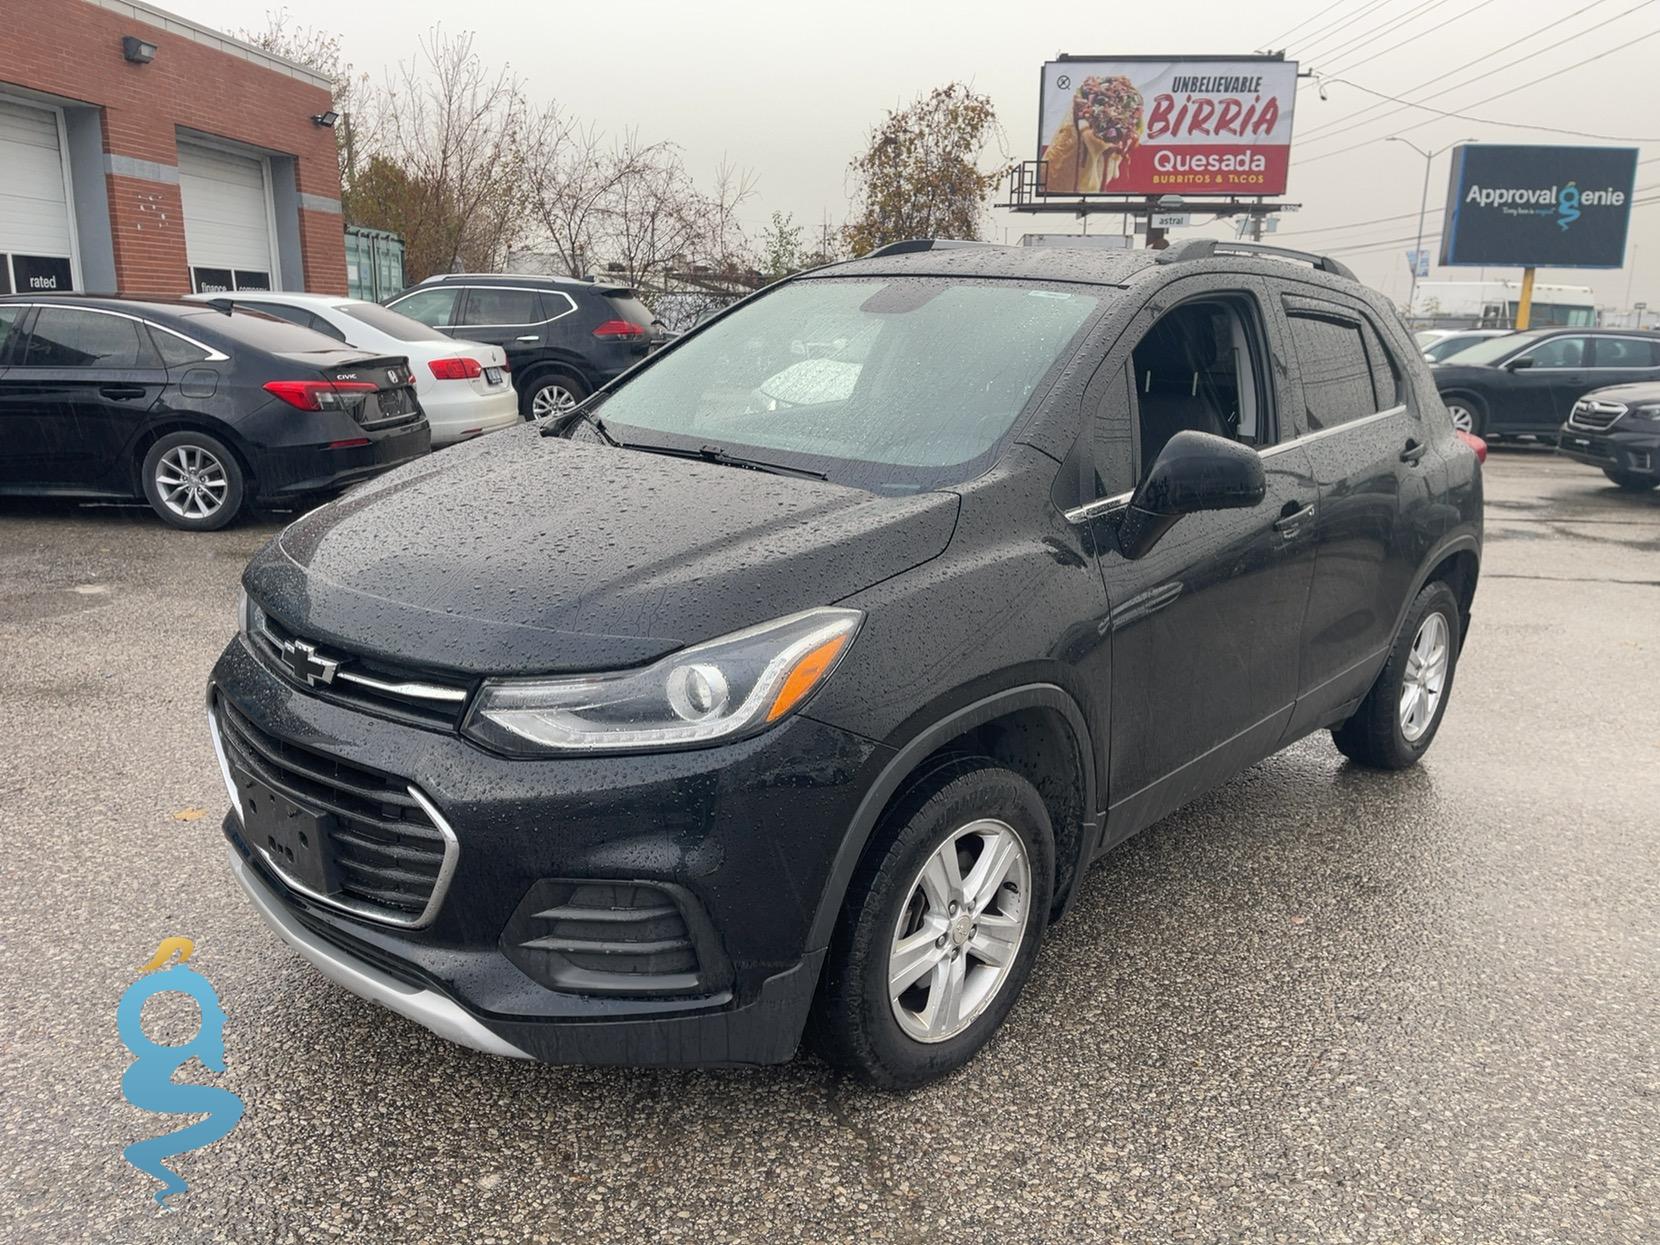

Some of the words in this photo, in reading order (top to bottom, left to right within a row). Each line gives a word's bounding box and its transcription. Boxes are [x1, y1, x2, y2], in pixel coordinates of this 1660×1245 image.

[1172, 75, 1262, 94] UNBELIEVABLE
[1153, 150, 1265, 172] Quesada
[1152, 174, 1210, 184] BURRITOS
[1215, 175, 1222, 183] &
[1229, 174, 1264, 184] TACOS
[1159, 216, 1184, 225] astral
[30, 275, 56, 288] rated
